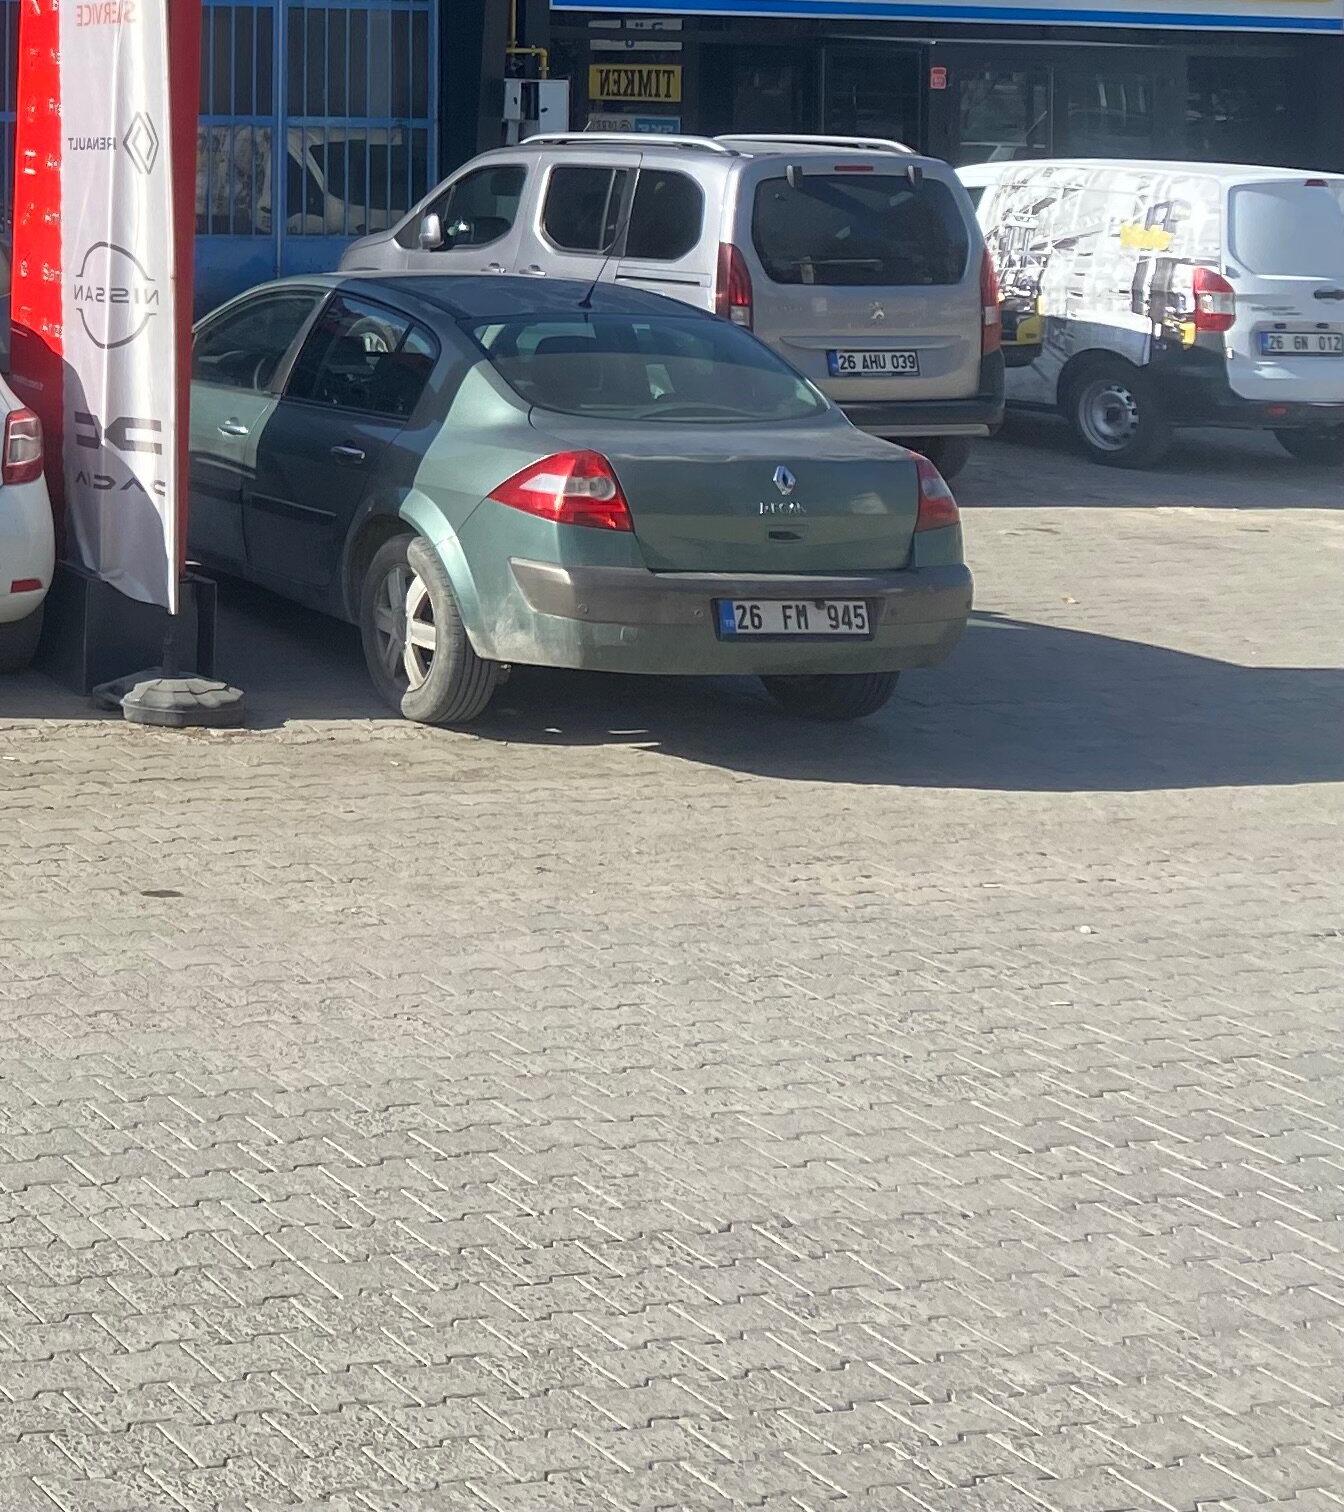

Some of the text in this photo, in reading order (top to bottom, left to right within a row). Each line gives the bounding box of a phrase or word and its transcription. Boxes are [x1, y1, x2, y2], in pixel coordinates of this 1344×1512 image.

[1269, 336, 1284, 349] 26
[1319, 336, 1341, 351] 012
[839, 354, 916, 370] 26 AHU 039
[735, 604, 865, 630] 26 FM 945
